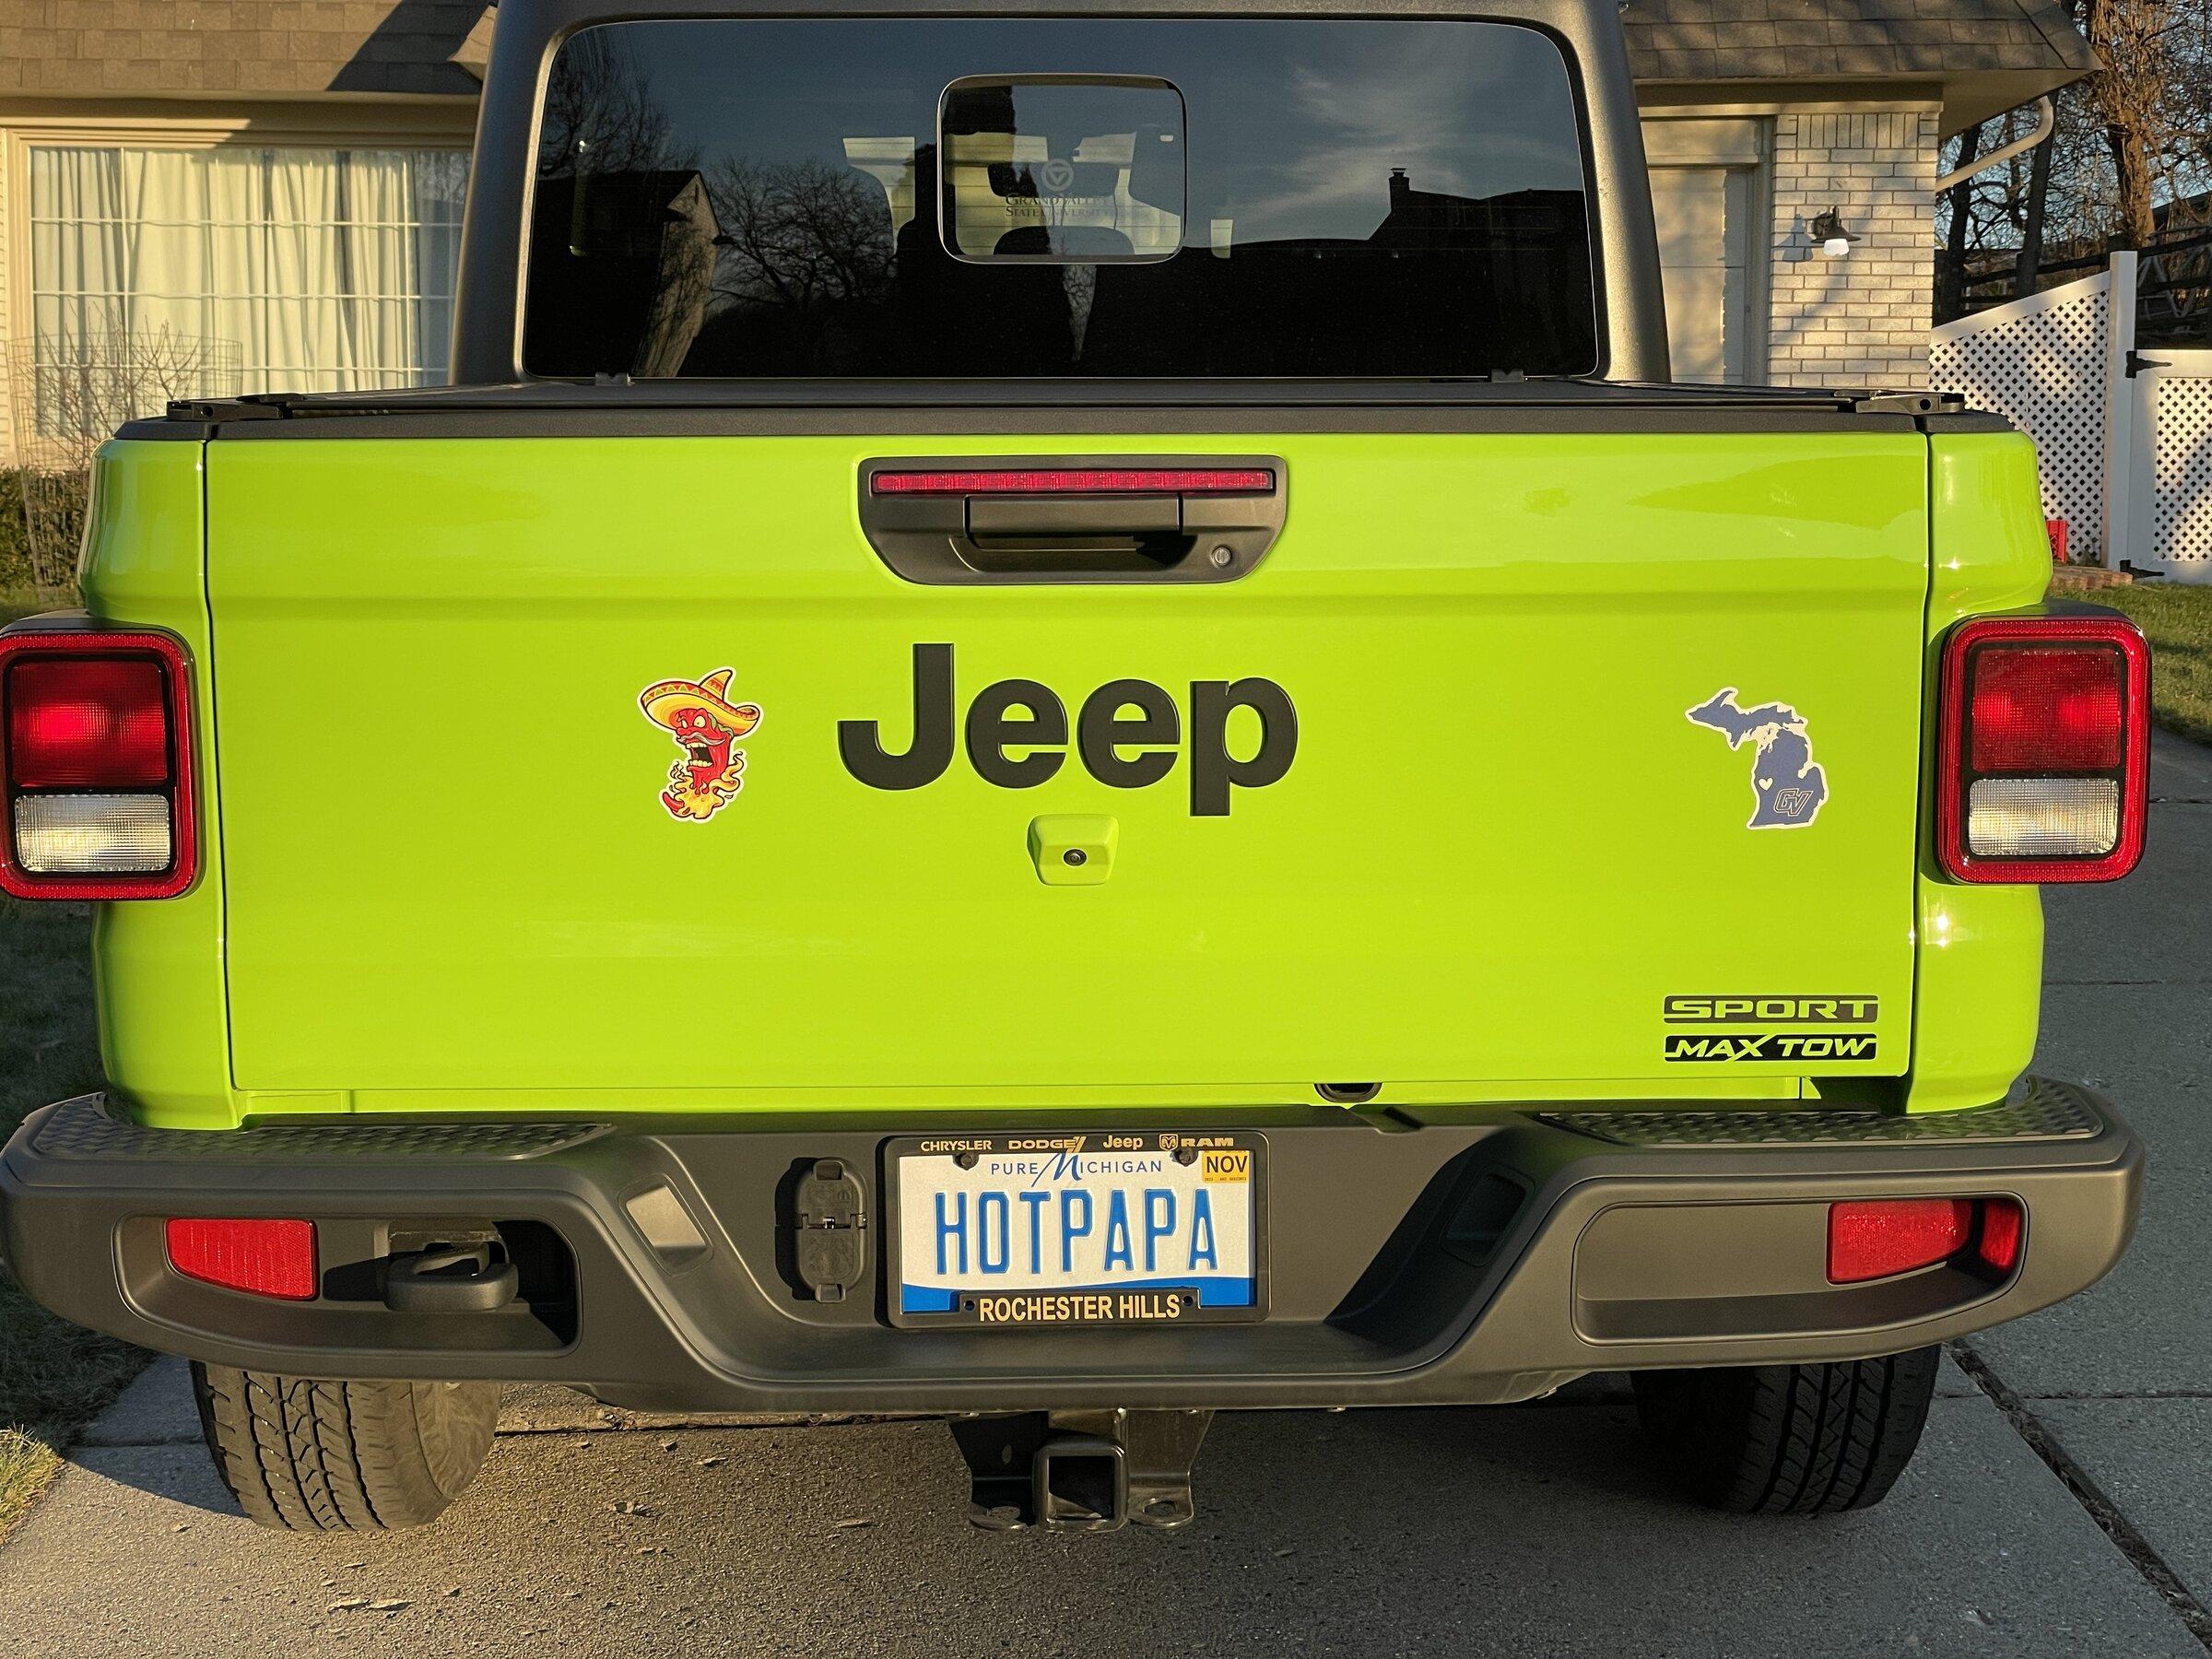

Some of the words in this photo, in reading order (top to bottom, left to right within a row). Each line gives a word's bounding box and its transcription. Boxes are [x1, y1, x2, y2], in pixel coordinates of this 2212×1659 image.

[1006, 206, 1041, 217] STATE
[837, 642, 1298, 817] Jeep
[1774, 788, 1813, 816] GV
[1665, 1000, 1878, 1018] SPORT
[1665, 1034, 1775, 1062] MAX
[1777, 1038, 1877, 1056] TOW
[921, 1139, 993, 1152] CHRYSLER
[1008, 1139, 1078, 1150] DODGE
[1103, 1135, 1144, 1150] Jeep
[1181, 1137, 1234, 1147] RAM
[991, 1162, 1039, 1175] PURE
[1031, 1152, 1162, 1187] MICHIGAN
[1206, 1155, 1248, 1173] NOV
[935, 1190, 1218, 1275] HOTPAPA
[979, 1296, 1113, 1323] ROCHESTER
[1119, 1294, 1181, 1320] HILLS
